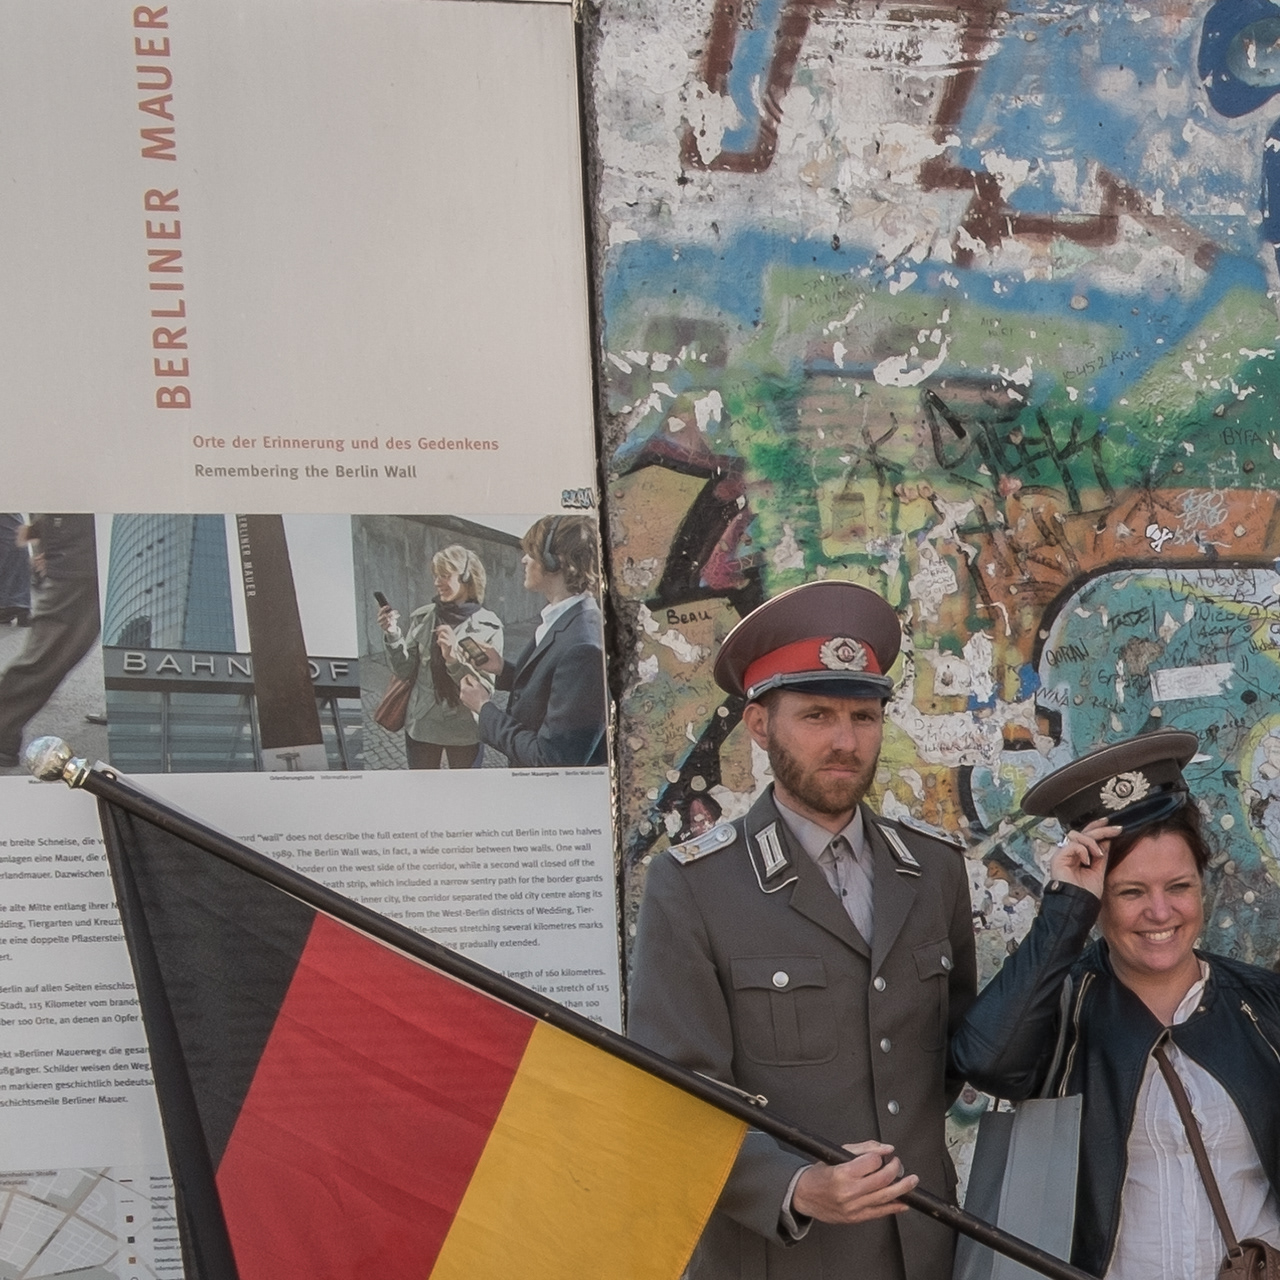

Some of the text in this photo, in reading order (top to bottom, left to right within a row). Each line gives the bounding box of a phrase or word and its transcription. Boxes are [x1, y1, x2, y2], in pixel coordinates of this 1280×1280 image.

[133, 7, 191, 410] BERLINER MAUER
[193, 435, 499, 452] Orte der Erinnerung und des Gedenkens
[195, 465, 416, 480] Remembering the Berlin Wall
[238, 513, 252, 557] ERLINER
[286, 833, 306, 841] does
[308, 833, 322, 841] not
[324, 832, 360, 840] describe
[361, 832, 375, 840] the
[392, 831, 418, 839] extent
[445, 830, 473, 838] barrier
[501, 829, 514, 837] cut
[541, 828, 557, 836] into
[559, 828, 575, 836] two
[297, 849, 312, 857] The
[314, 849, 339, 857] Berlin
[341, 848, 359, 856] Wall
[392, 847, 410, 856] fact,
[441, 846, 474, 854] corridor
[476, 845, 512, 853] between
[512, 844, 529, 852] two
[530, 844, 554, 852] walls.
[556, 843, 572, 851] One
[574, 843, 591, 851] wall
[9, 902, 109, 912] alte Mitte entlang ihrer
[35, 1016, 57, 1025] Orte,
[72, 1016, 99, 1024] denen
[114, 1015, 139, 1023] Opfer
